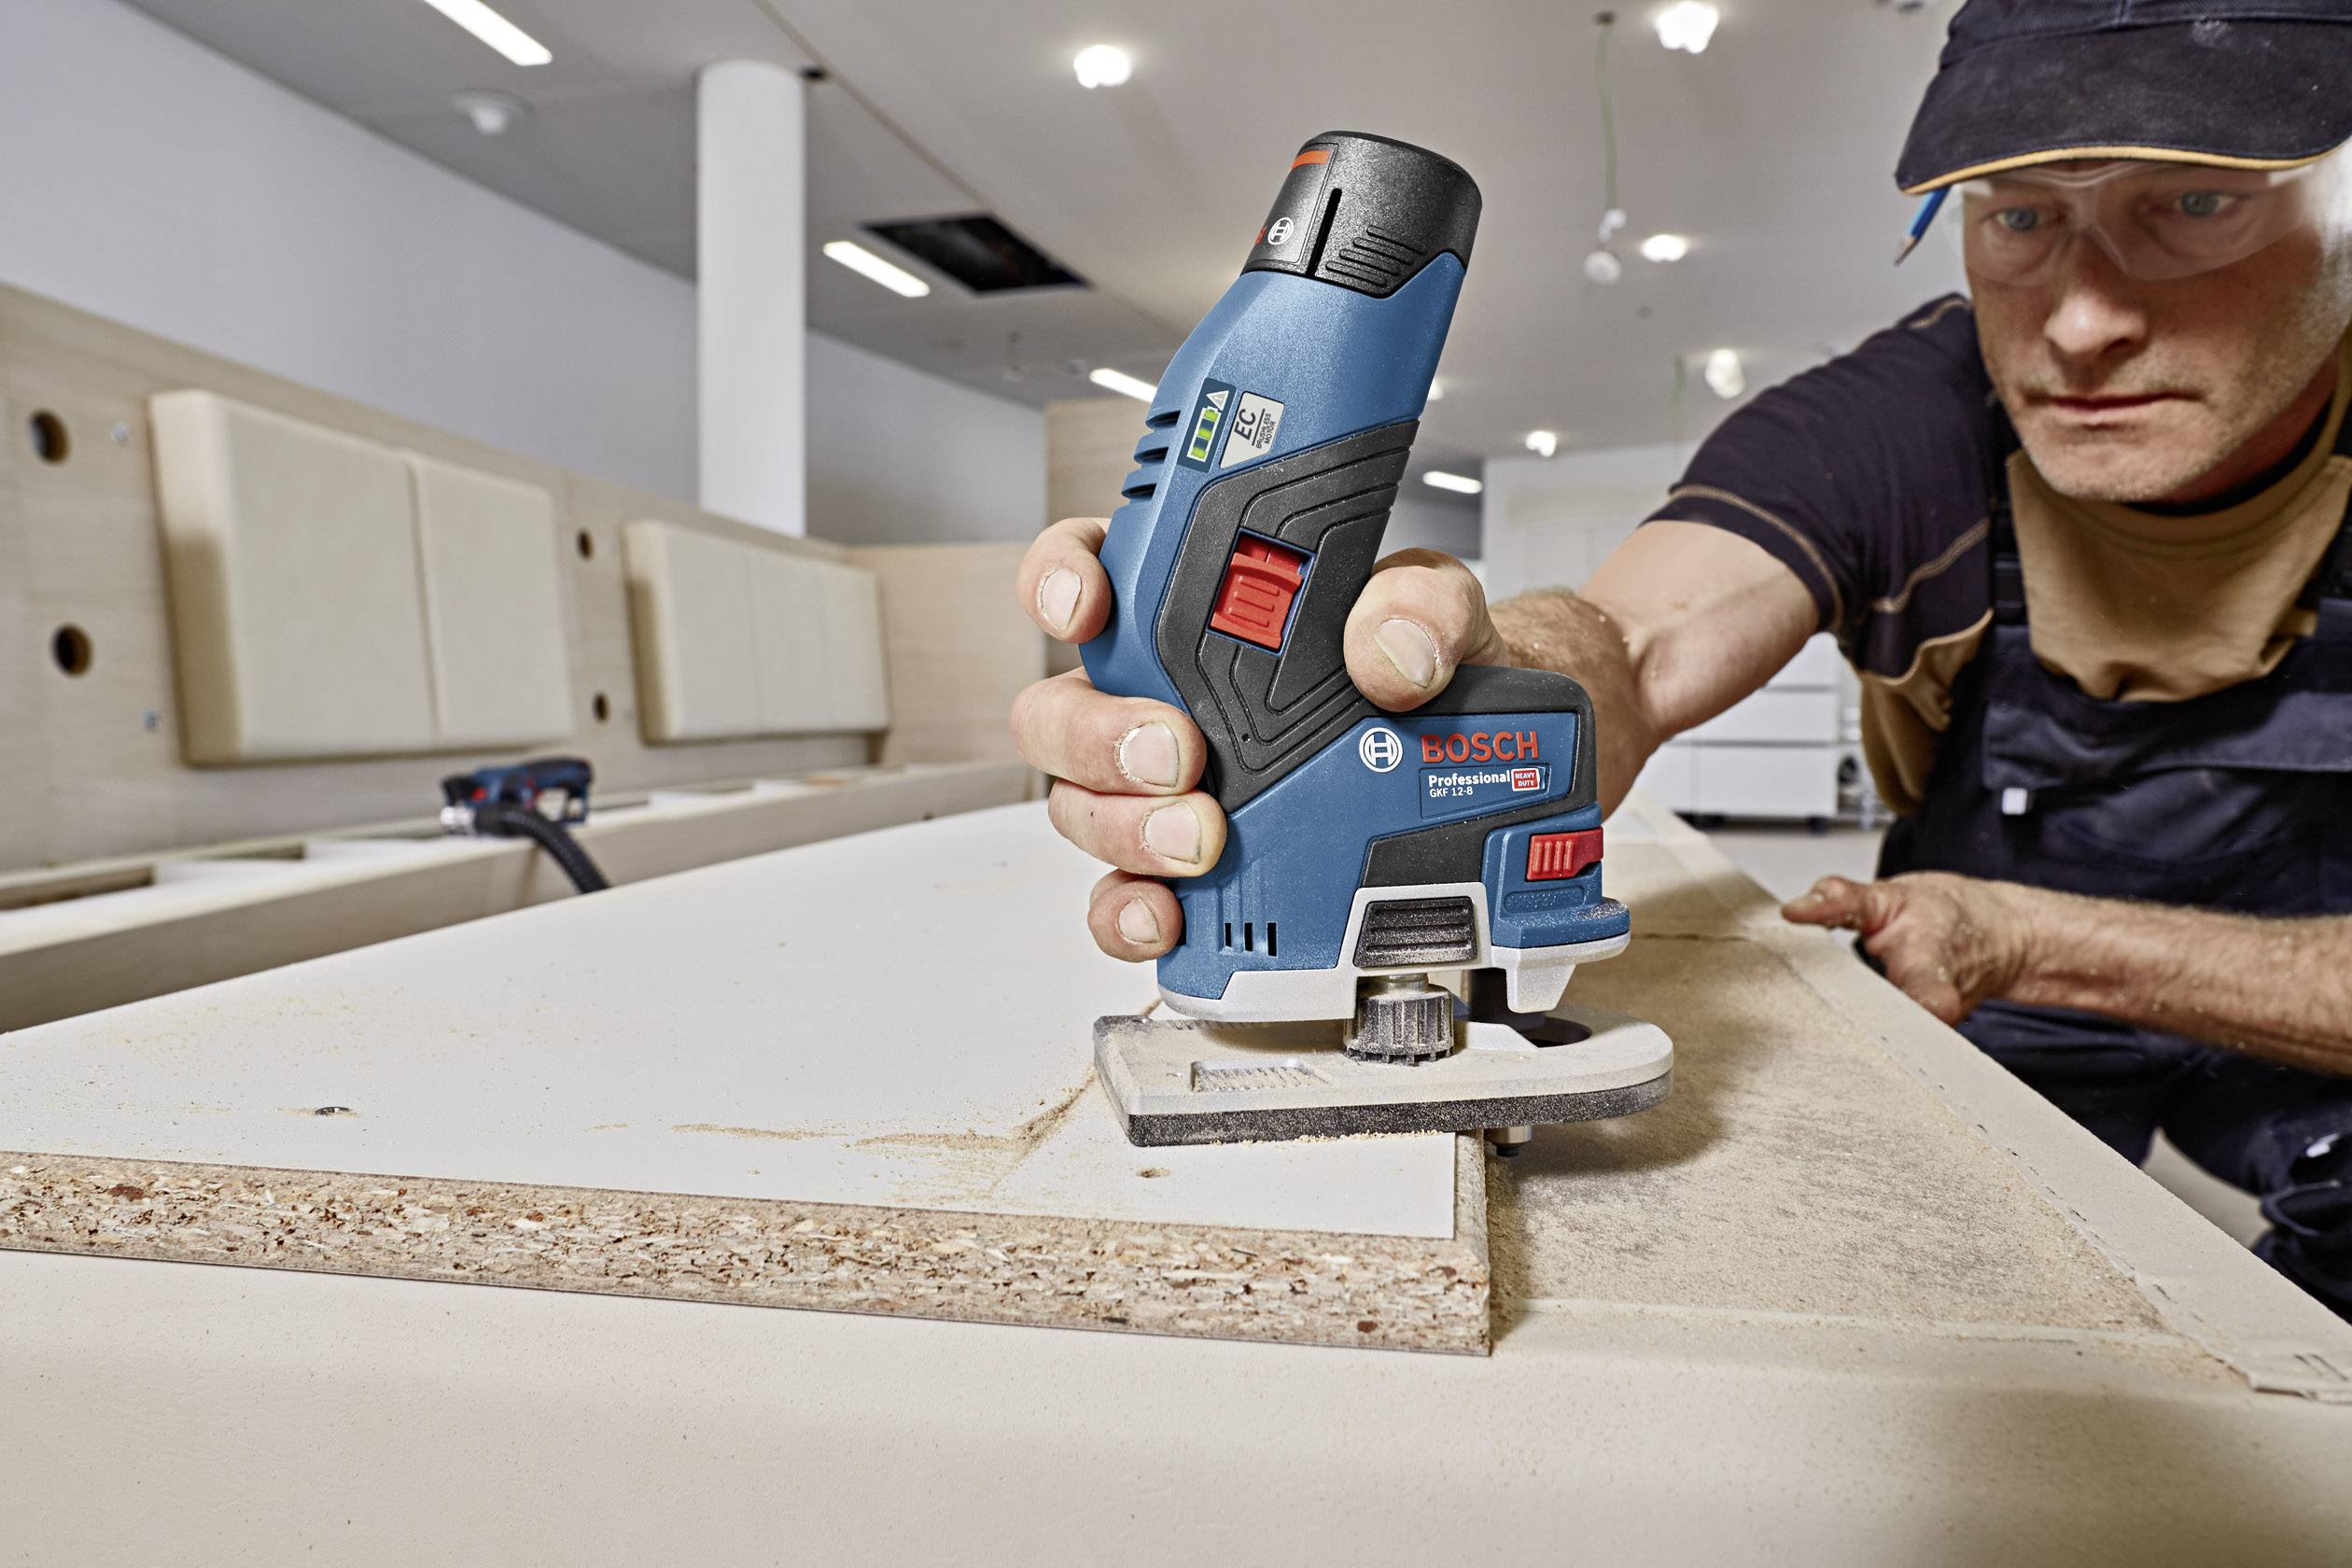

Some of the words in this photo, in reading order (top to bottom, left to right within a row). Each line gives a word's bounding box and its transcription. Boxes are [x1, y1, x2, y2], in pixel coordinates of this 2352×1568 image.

[1234, 408, 1256, 441] EC
[1255, 413, 1272, 449] BRUSHLESS
[1264, 420, 1277, 444] MOTOR
[1420, 731, 1539, 763] BOSCH
[1428, 769, 1511, 788] Professional
[1518, 779, 1534, 788] DUTY
[1429, 788, 1449, 798] GKF
[1451, 786, 1474, 797] 12-8
